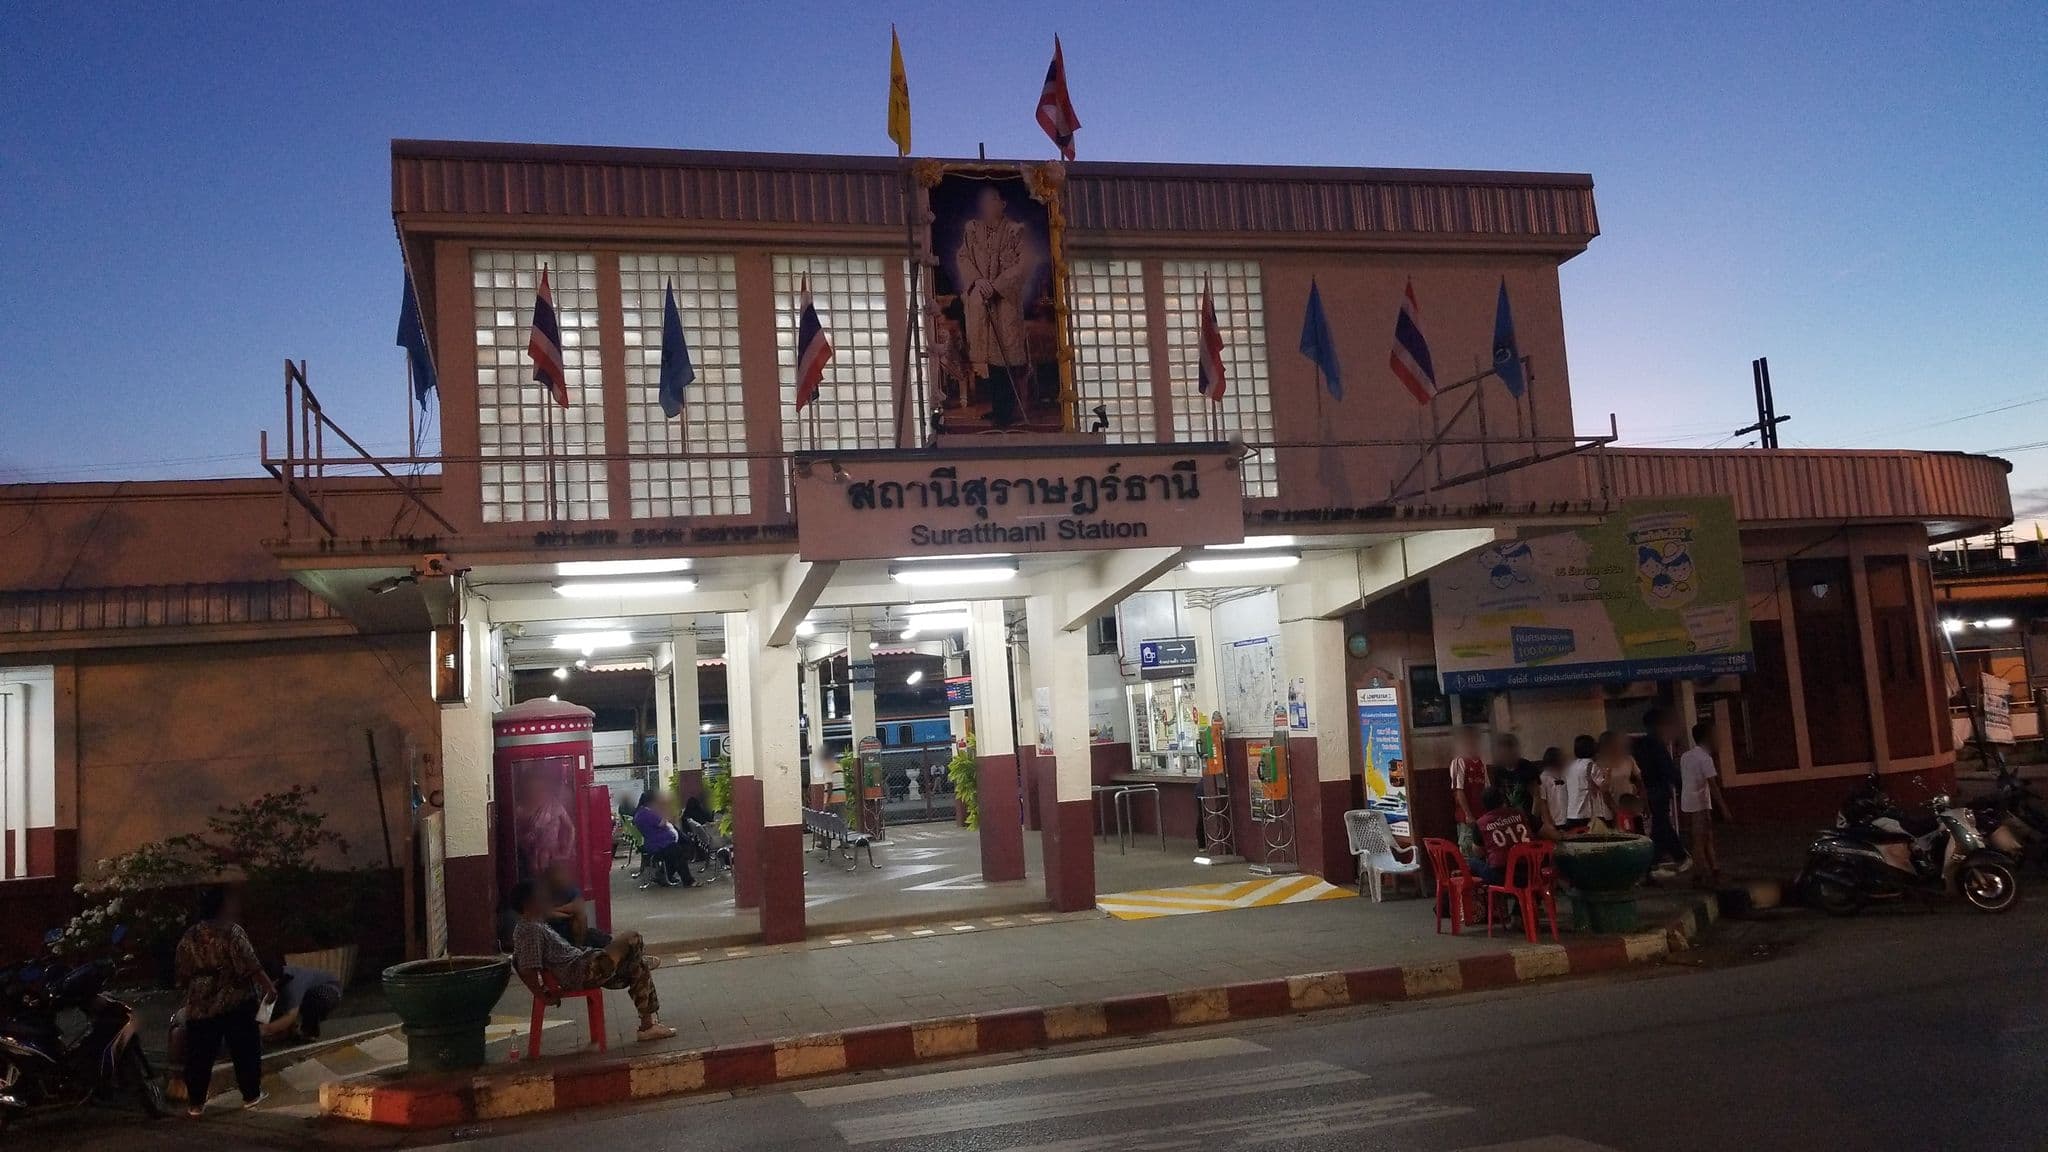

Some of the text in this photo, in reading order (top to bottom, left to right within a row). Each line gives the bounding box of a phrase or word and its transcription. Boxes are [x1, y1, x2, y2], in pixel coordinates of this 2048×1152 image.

[847, 458, 1200, 519] สถานีสุราษฎร์ธานี
[911, 518, 1148, 546] Suratthani Station
[1492, 824, 1530, 847] 012
